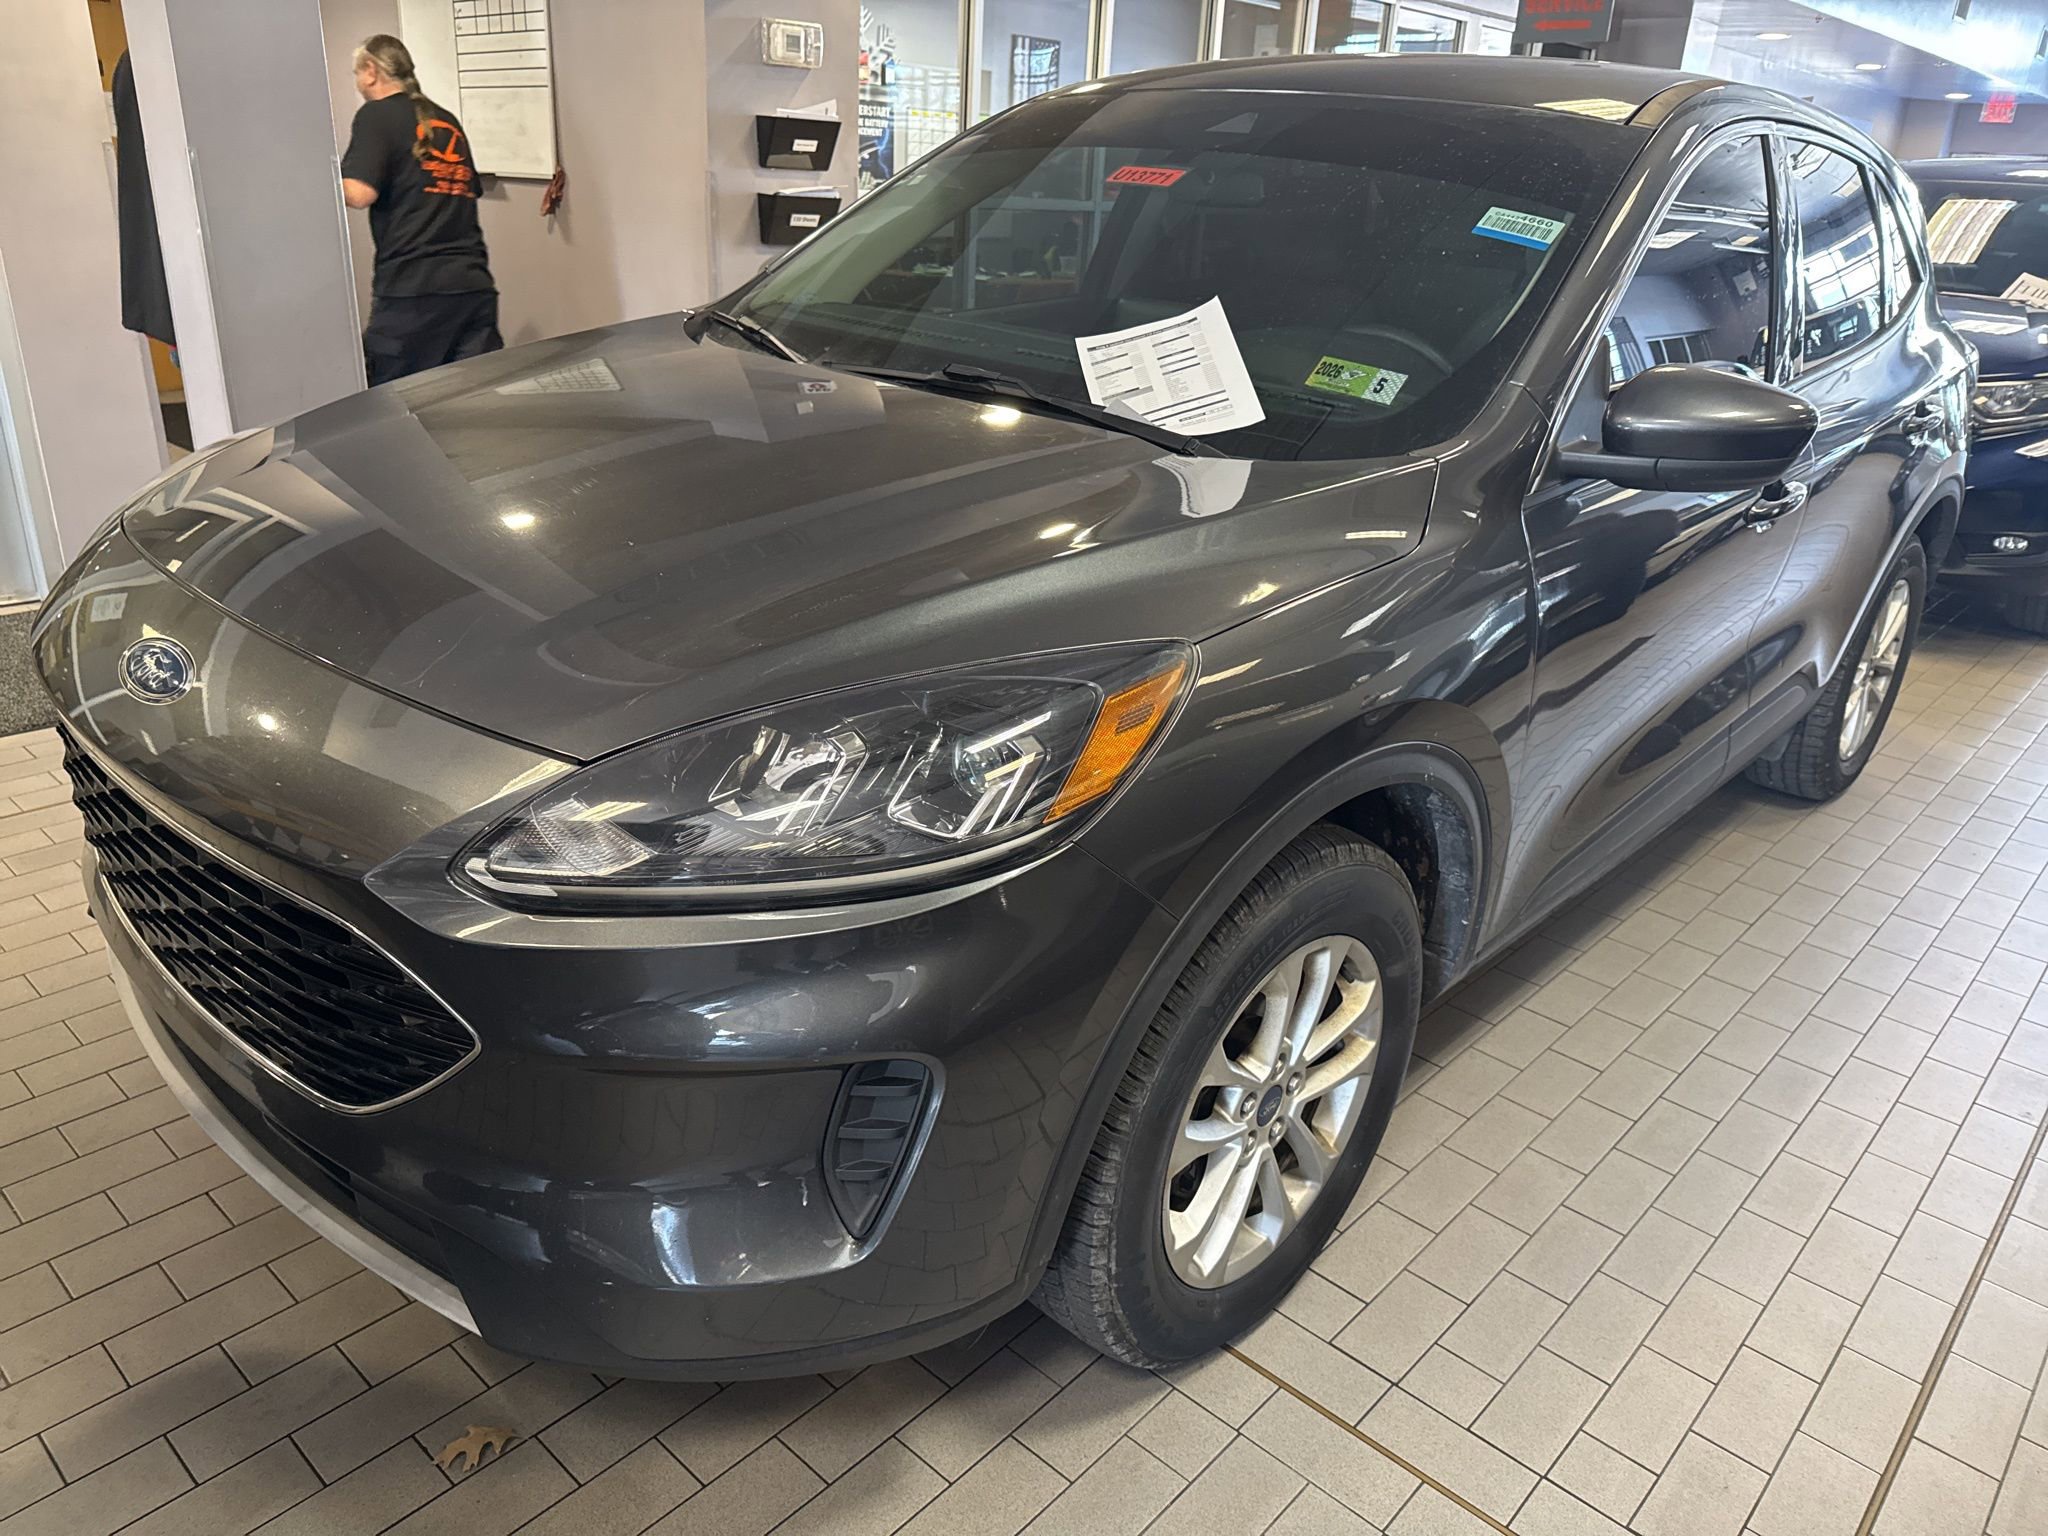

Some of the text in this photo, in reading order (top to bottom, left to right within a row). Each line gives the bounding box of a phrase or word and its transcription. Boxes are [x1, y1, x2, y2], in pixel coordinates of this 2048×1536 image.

[1113, 169, 1174, 184] U13771
[1315, 361, 1344, 379] 2026
[1372, 378, 1389, 394] 5
